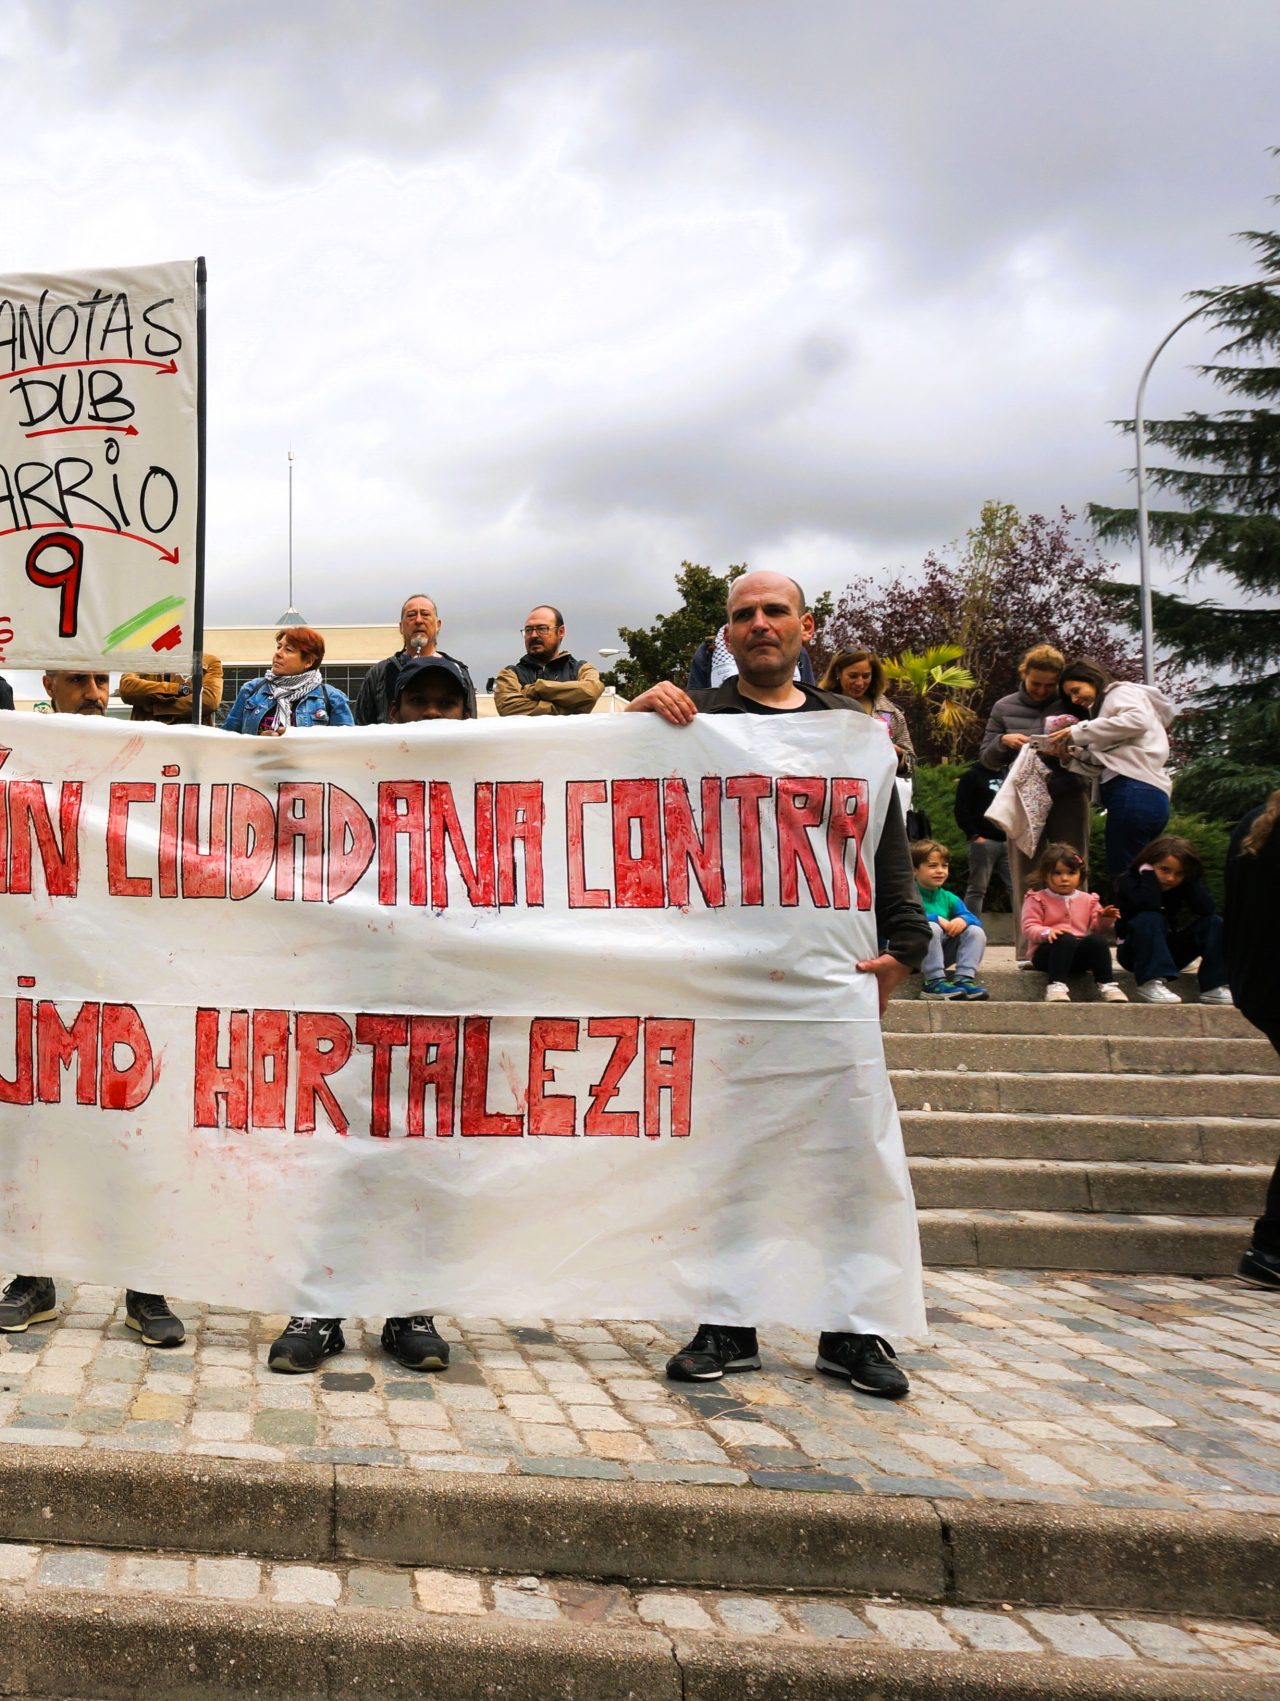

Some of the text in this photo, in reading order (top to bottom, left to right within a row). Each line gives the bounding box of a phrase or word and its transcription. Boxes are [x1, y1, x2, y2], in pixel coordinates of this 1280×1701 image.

[10, 369, 135, 427] DUB
[25, 532, 84, 638] 9
[566, 773, 872, 911] CONTRA
[194, 1007, 696, 1138] HORTALEZA
